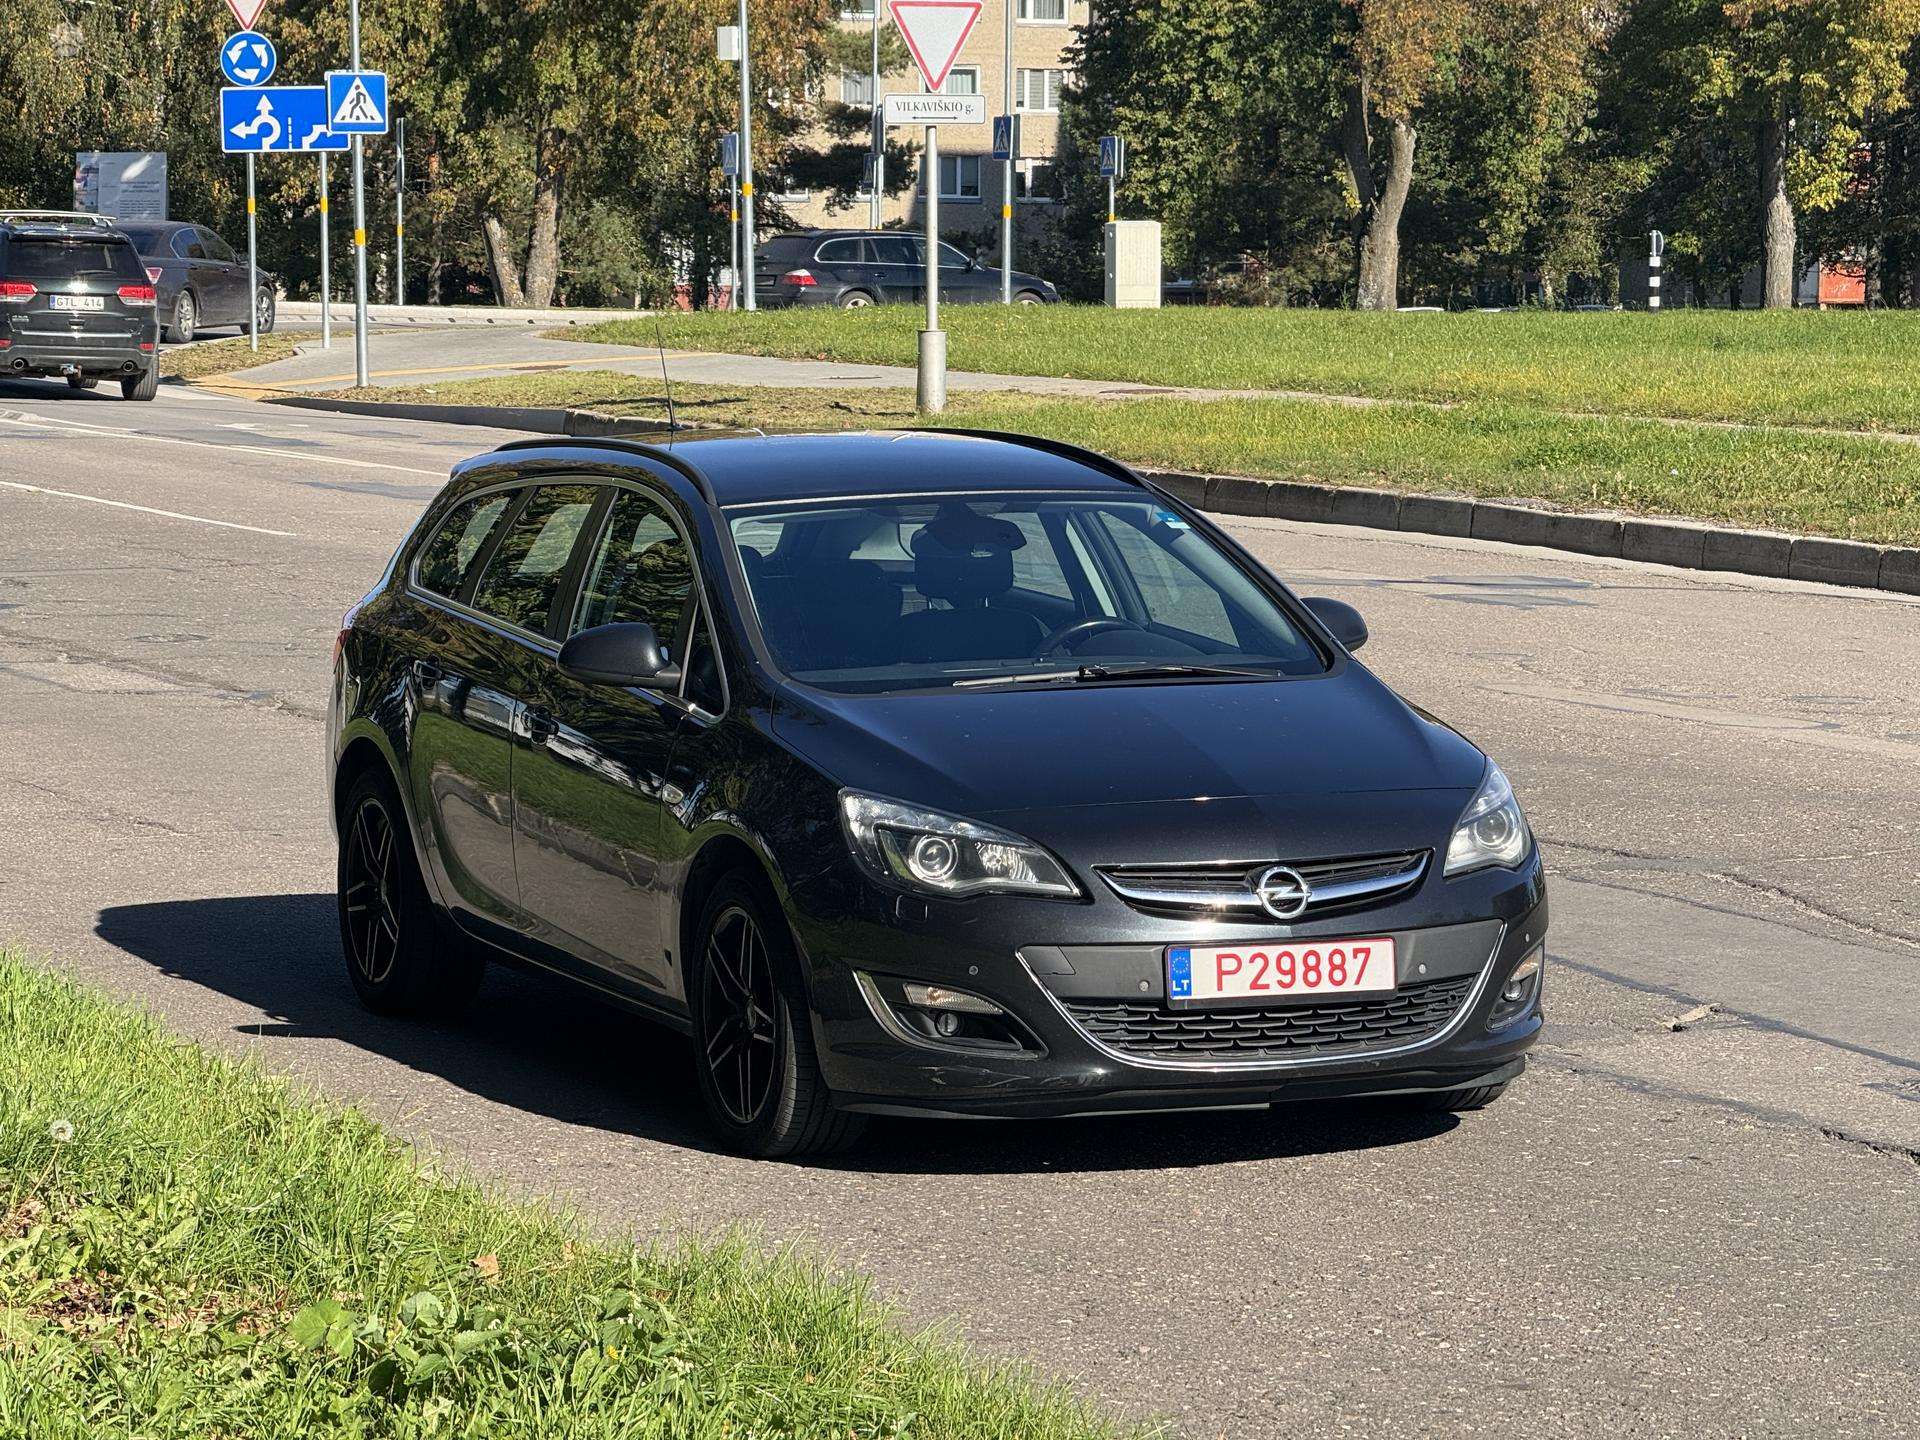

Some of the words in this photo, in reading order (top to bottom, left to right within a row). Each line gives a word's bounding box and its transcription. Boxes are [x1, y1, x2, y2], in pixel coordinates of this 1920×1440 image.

[896, 99, 963, 112] VILKAVIŠKIO
[965, 104, 974, 115] g.
[56, 297, 77, 307] GTL
[84, 297, 102, 307] 414
[1215, 946, 1372, 992] P29887
[1171, 979, 1190, 992] LT
